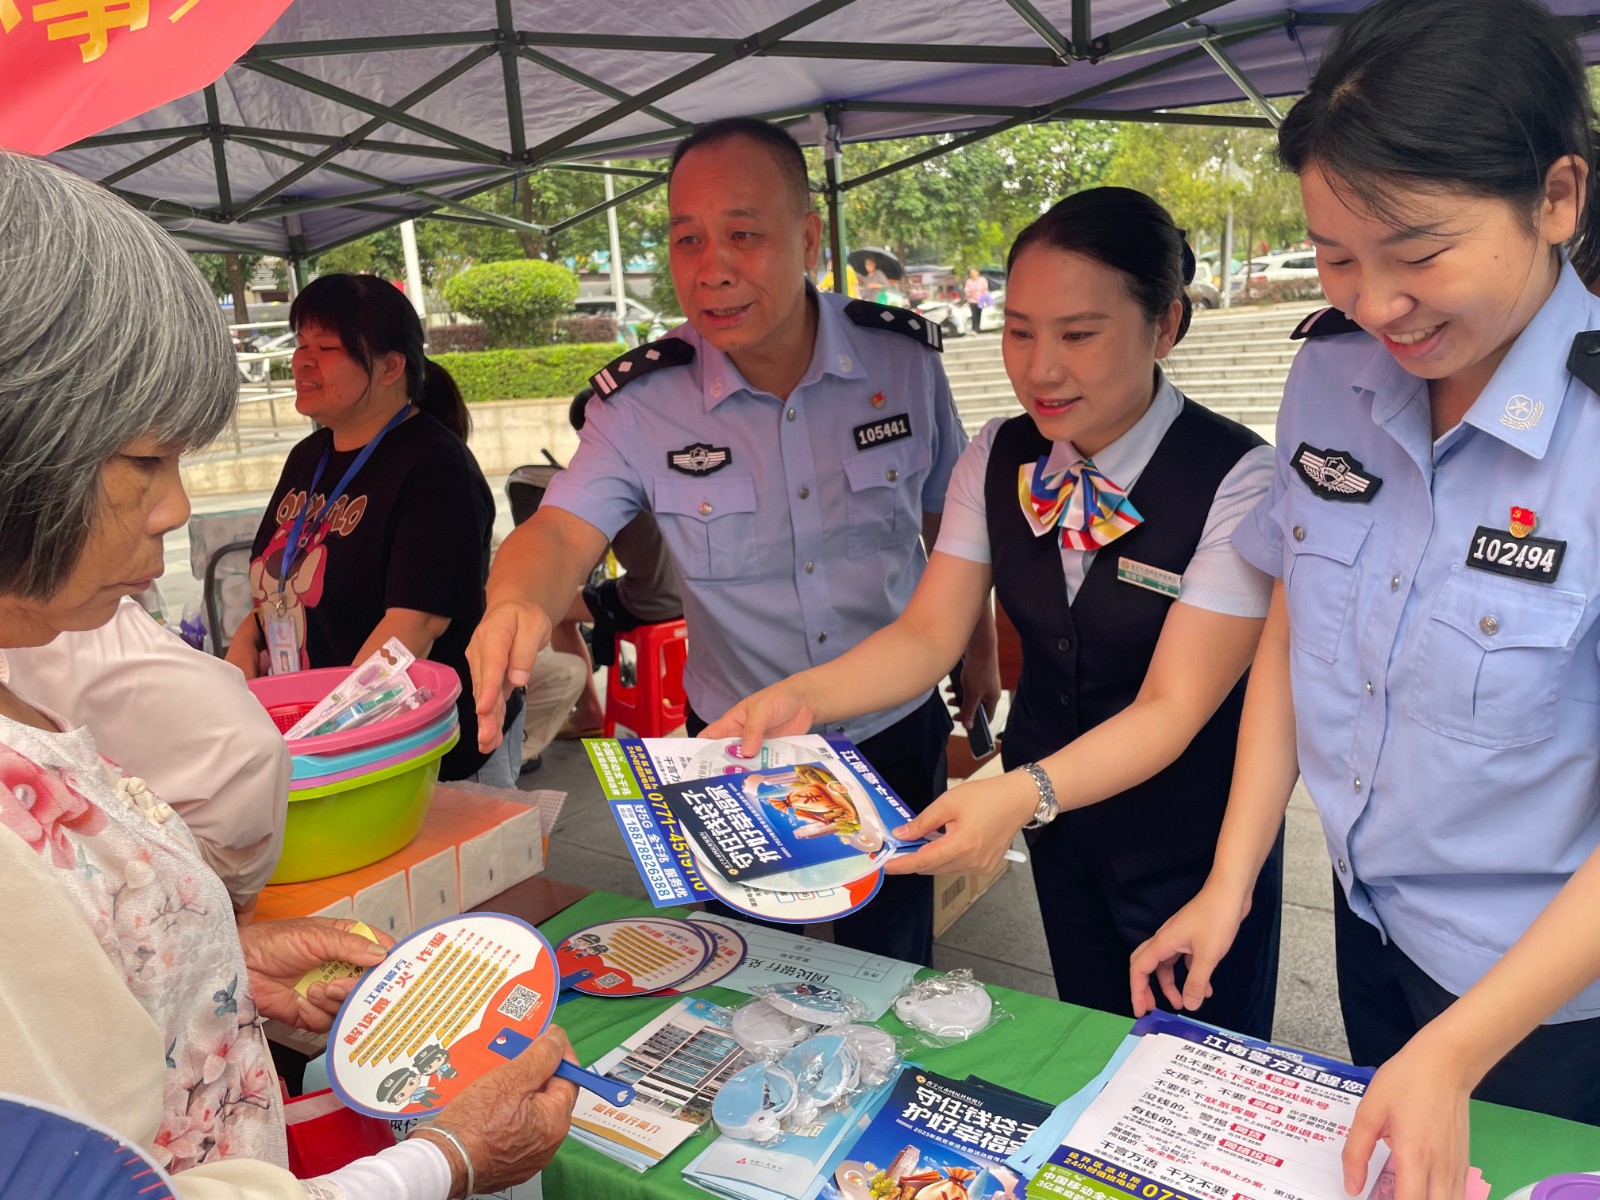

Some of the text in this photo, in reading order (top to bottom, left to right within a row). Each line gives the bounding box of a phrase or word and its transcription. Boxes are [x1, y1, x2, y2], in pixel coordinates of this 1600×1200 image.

[859, 420, 907, 445] 105441
[1473, 536, 1556, 573] 102494
[599, 741, 631, 795] 中国移动全千兆
[680, 789, 753, 868] 守住钱袋子
[704, 783, 782, 863] 护好幸福家
[625, 820, 670, 896] 18878826388
[632, 804, 688, 898] 好5G 全千兆 服务优
[363, 957, 407, 1005] 江南警方
[1174, 1053, 1330, 1111] 也不要私下买卖游戏账号
[1202, 1033, 1366, 1095] 江南警方提醒您
[592, 1103, 661, 1134] 国民银行简介
[915, 1086, 1038, 1141] 守住钱袋子
[1062, 1157, 1137, 1190] 24小时值班电话
[1098, 1139, 1229, 1196] 千言万语 千万不要
[1142, 1184, 1188, 1200] 07
